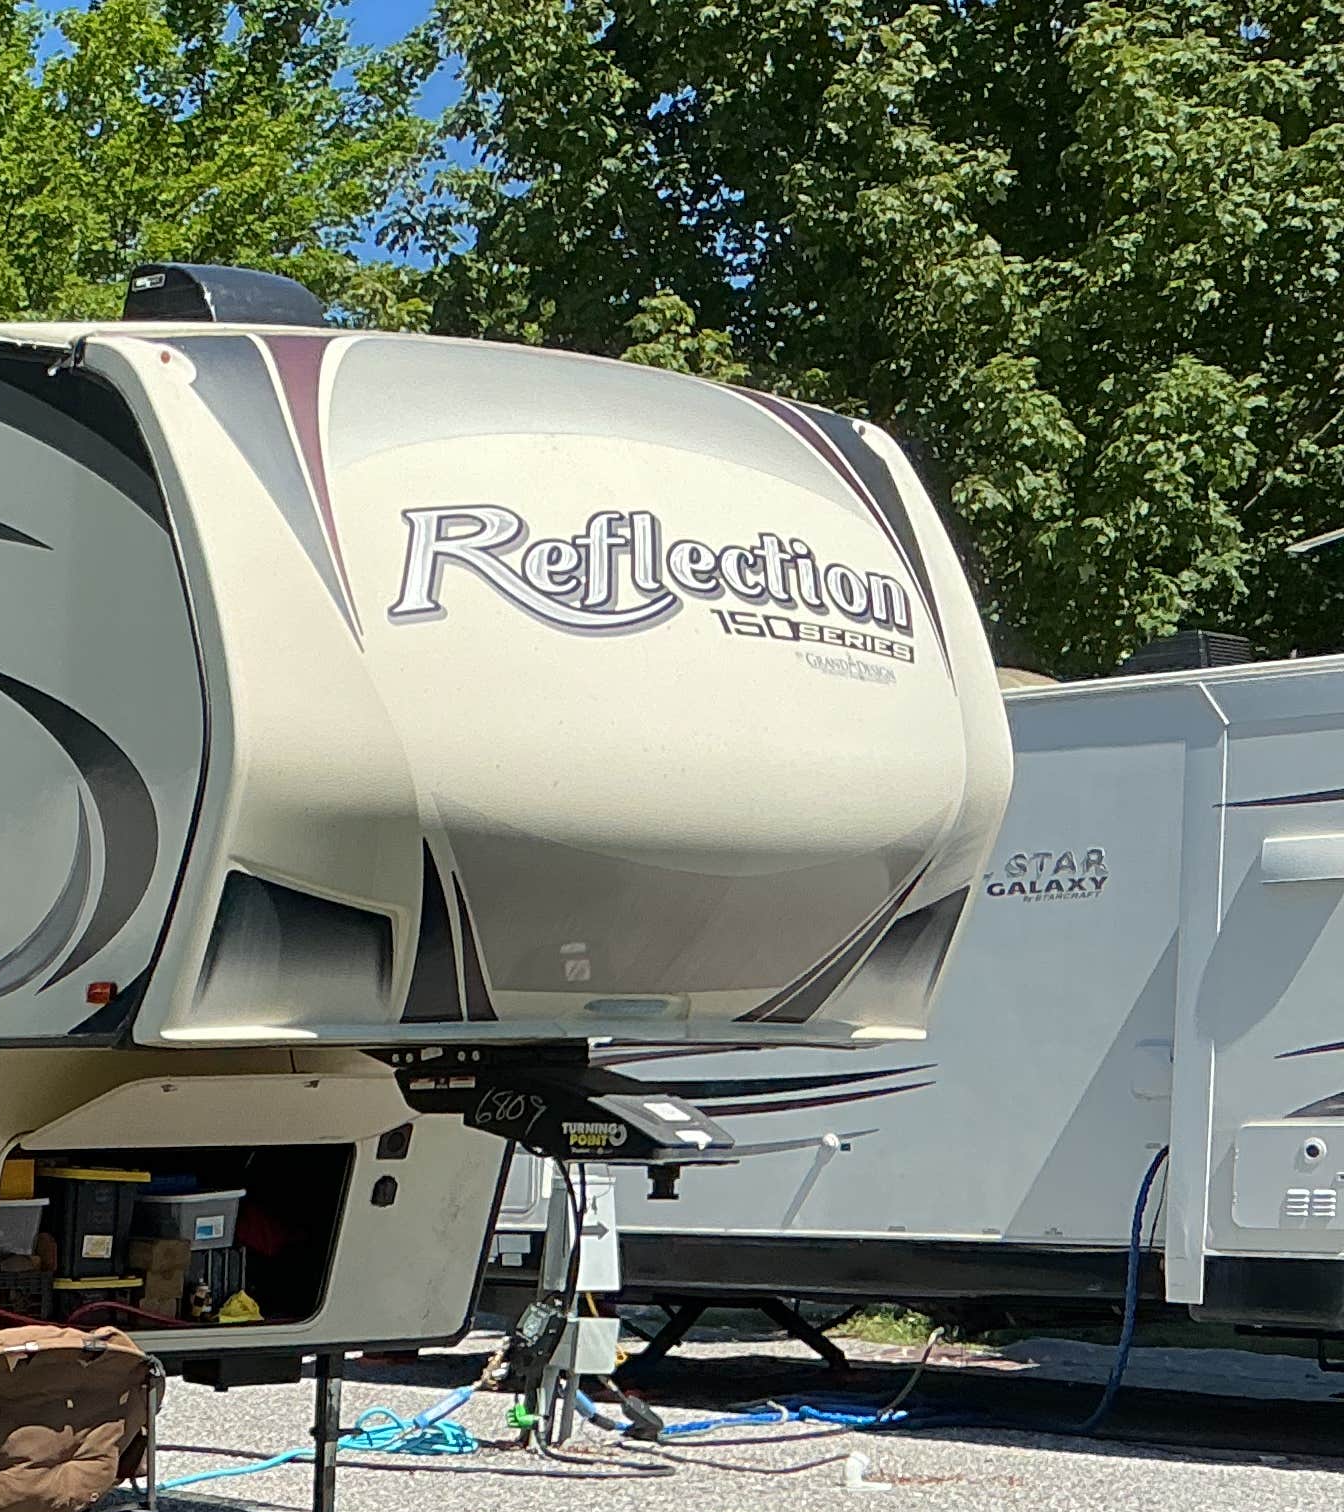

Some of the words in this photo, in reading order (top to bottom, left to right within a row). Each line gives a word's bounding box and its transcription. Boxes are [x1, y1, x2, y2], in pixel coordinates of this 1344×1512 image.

[387, 504, 914, 637] Reflection
[710, 608, 800, 642] 150
[798, 621, 915, 663] SERIES
[1004, 847, 1110, 878] STAR
[986, 876, 1109, 897] GALAXY
[562, 1122, 618, 1135] TURNING
[569, 1134, 610, 1147] POINT
